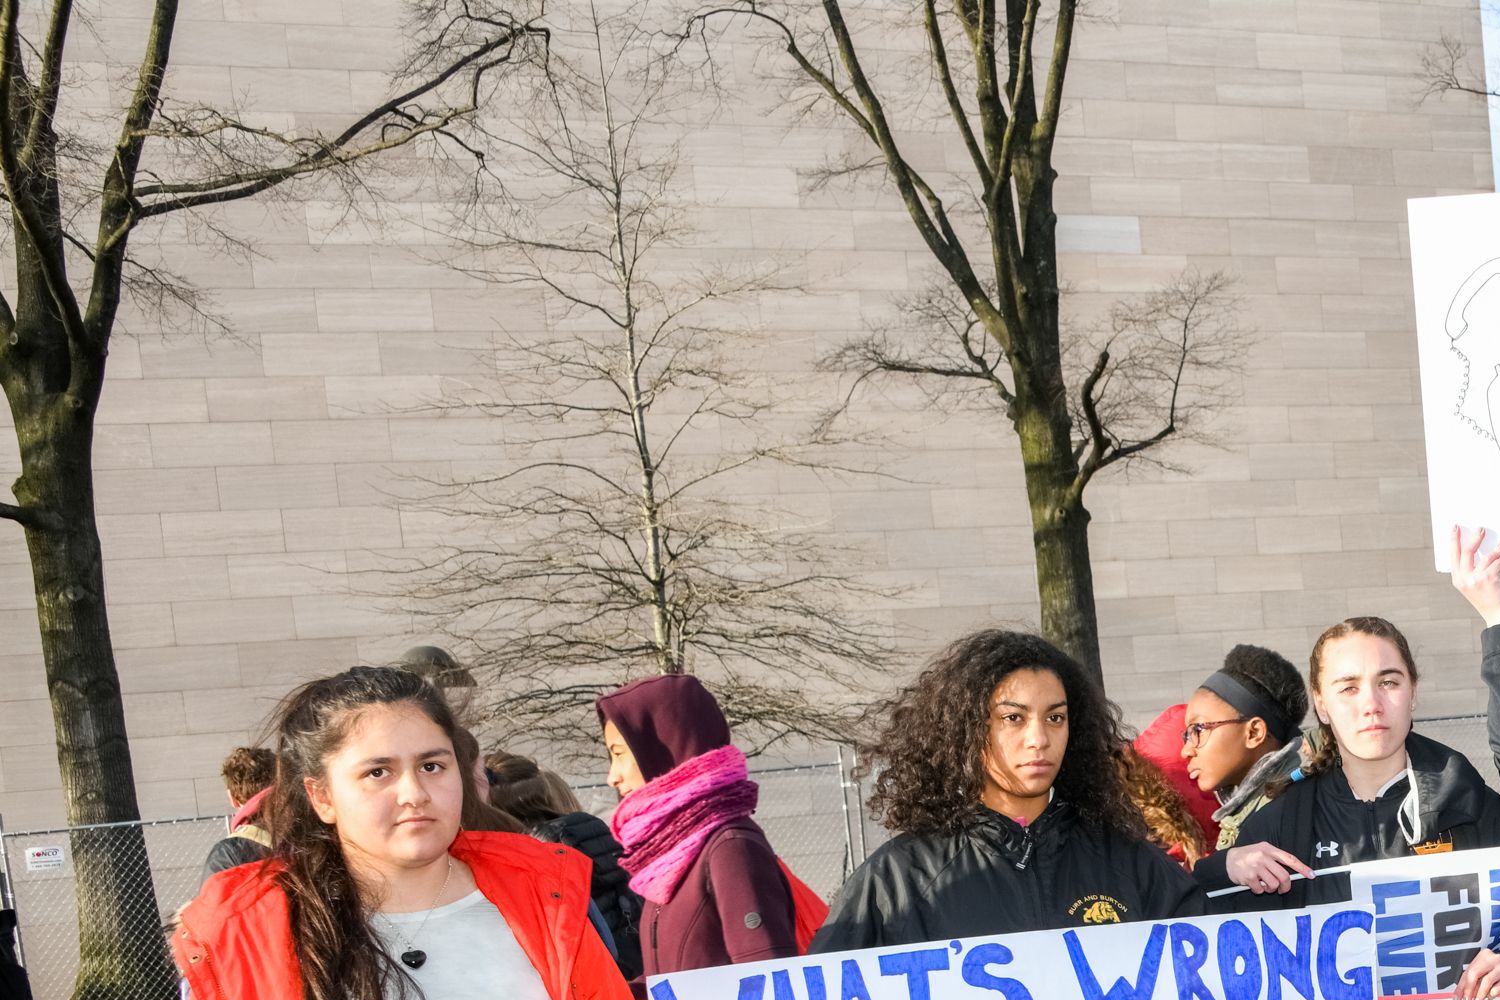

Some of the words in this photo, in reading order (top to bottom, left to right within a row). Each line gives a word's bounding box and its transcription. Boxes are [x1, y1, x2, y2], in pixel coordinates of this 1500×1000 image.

[1068, 899, 1084, 916] BURR
[1083, 894, 1098, 903] AND
[1099, 894, 1129, 913] BURTON
[1371, 880, 1428, 996] LIVE
